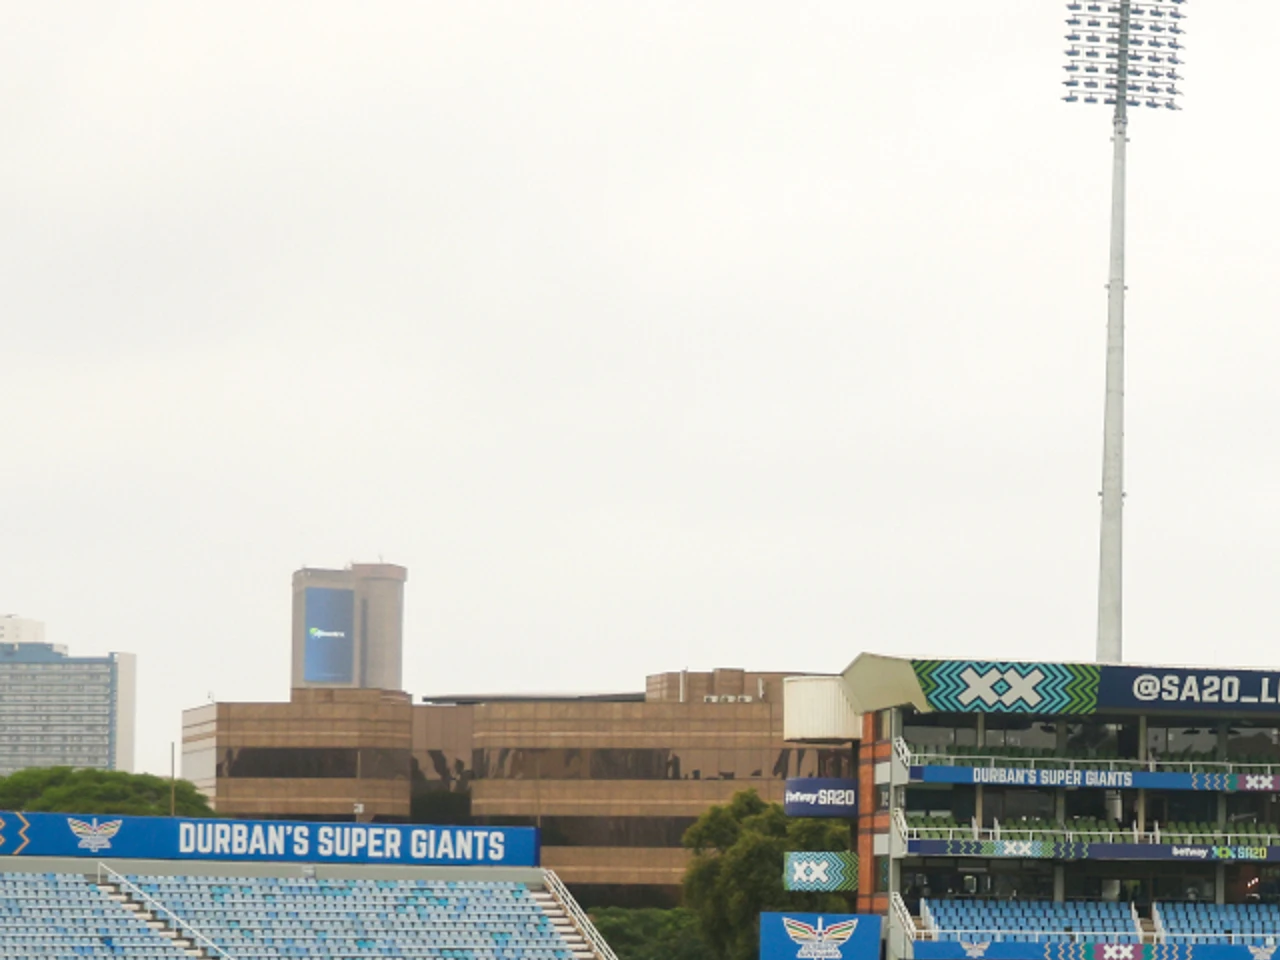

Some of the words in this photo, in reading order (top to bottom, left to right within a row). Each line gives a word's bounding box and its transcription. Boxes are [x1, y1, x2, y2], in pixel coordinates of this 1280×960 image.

[972, 766, 1036, 786] DURBAN'S
[1040, 768, 1081, 787] SUPER
[1085, 770, 1133, 788] GIANTS
[179, 821, 309, 856] DURBAN'S
[317, 825, 401, 858] SUPER
[410, 829, 505, 861] GIANTS
[1172, 845, 1208, 859] betway
